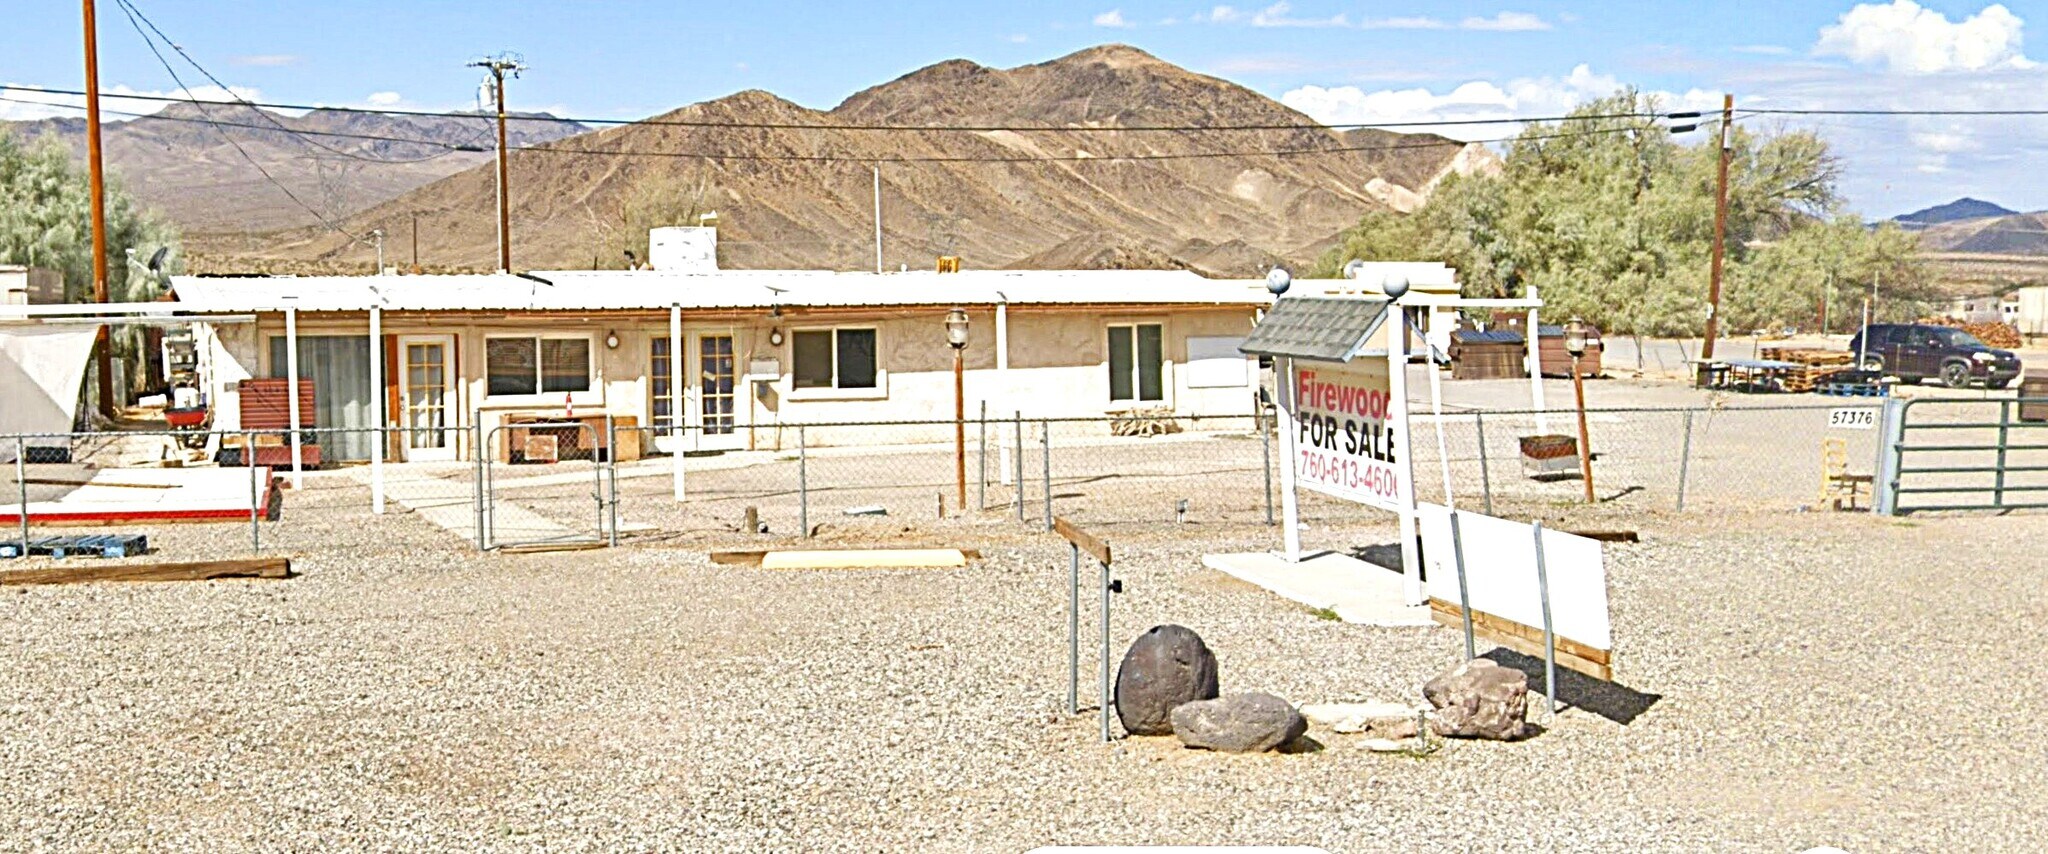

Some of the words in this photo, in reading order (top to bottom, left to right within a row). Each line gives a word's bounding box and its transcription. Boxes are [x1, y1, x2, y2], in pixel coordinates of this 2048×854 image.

[1832, 411, 1873, 425] 57376
[1300, 411, 1338, 451] FOR
[1344, 419, 1396, 464] SALE
